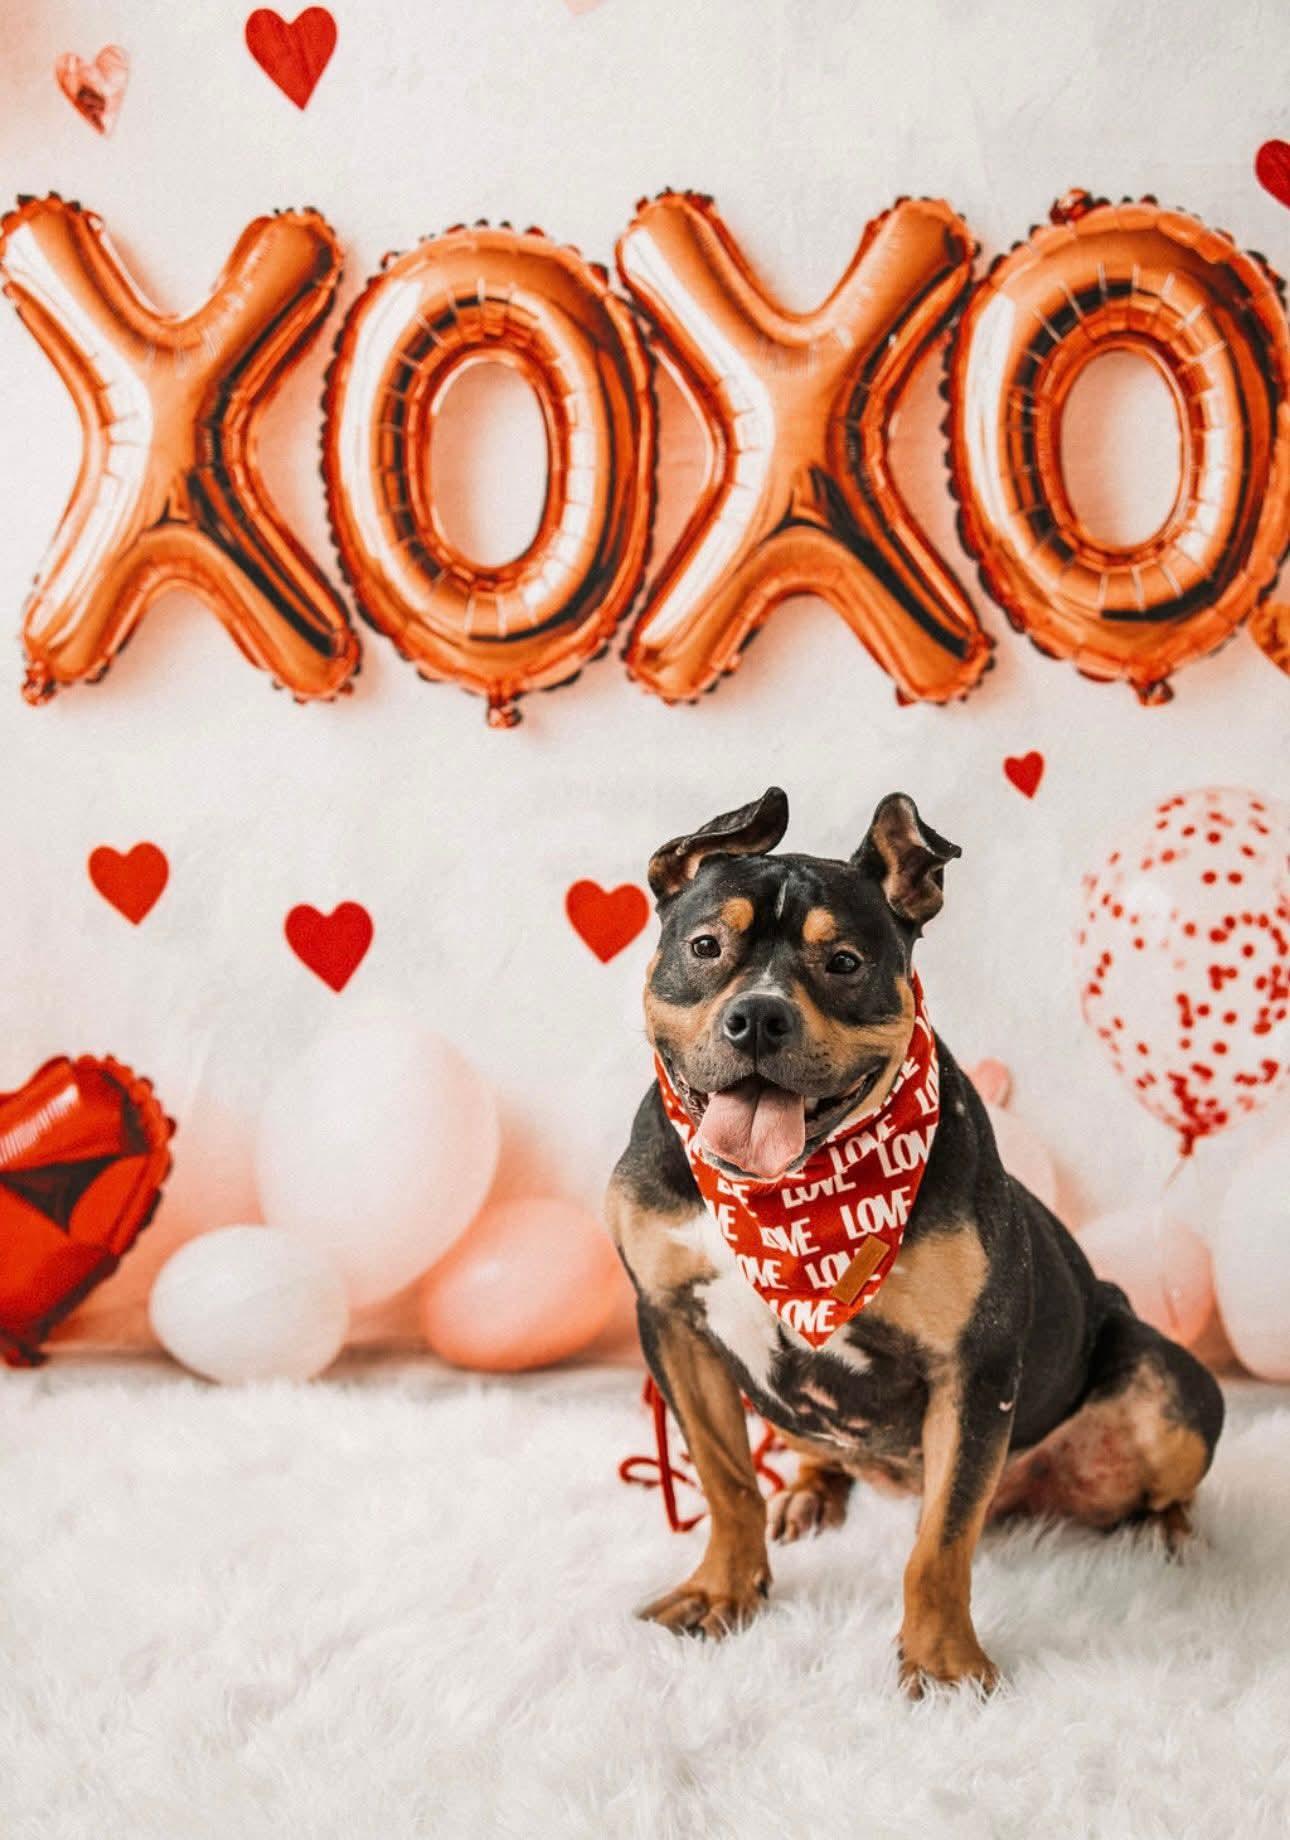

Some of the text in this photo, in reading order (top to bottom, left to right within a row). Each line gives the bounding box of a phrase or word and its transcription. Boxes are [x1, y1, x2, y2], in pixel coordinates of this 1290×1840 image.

[829, 1113, 897, 1175] LOVE
[875, 1122, 938, 1178] LOV
[760, 1217, 821, 1257] OVE
[839, 1186, 912, 1240] LOVE
[736, 1254, 789, 1290] OVE
